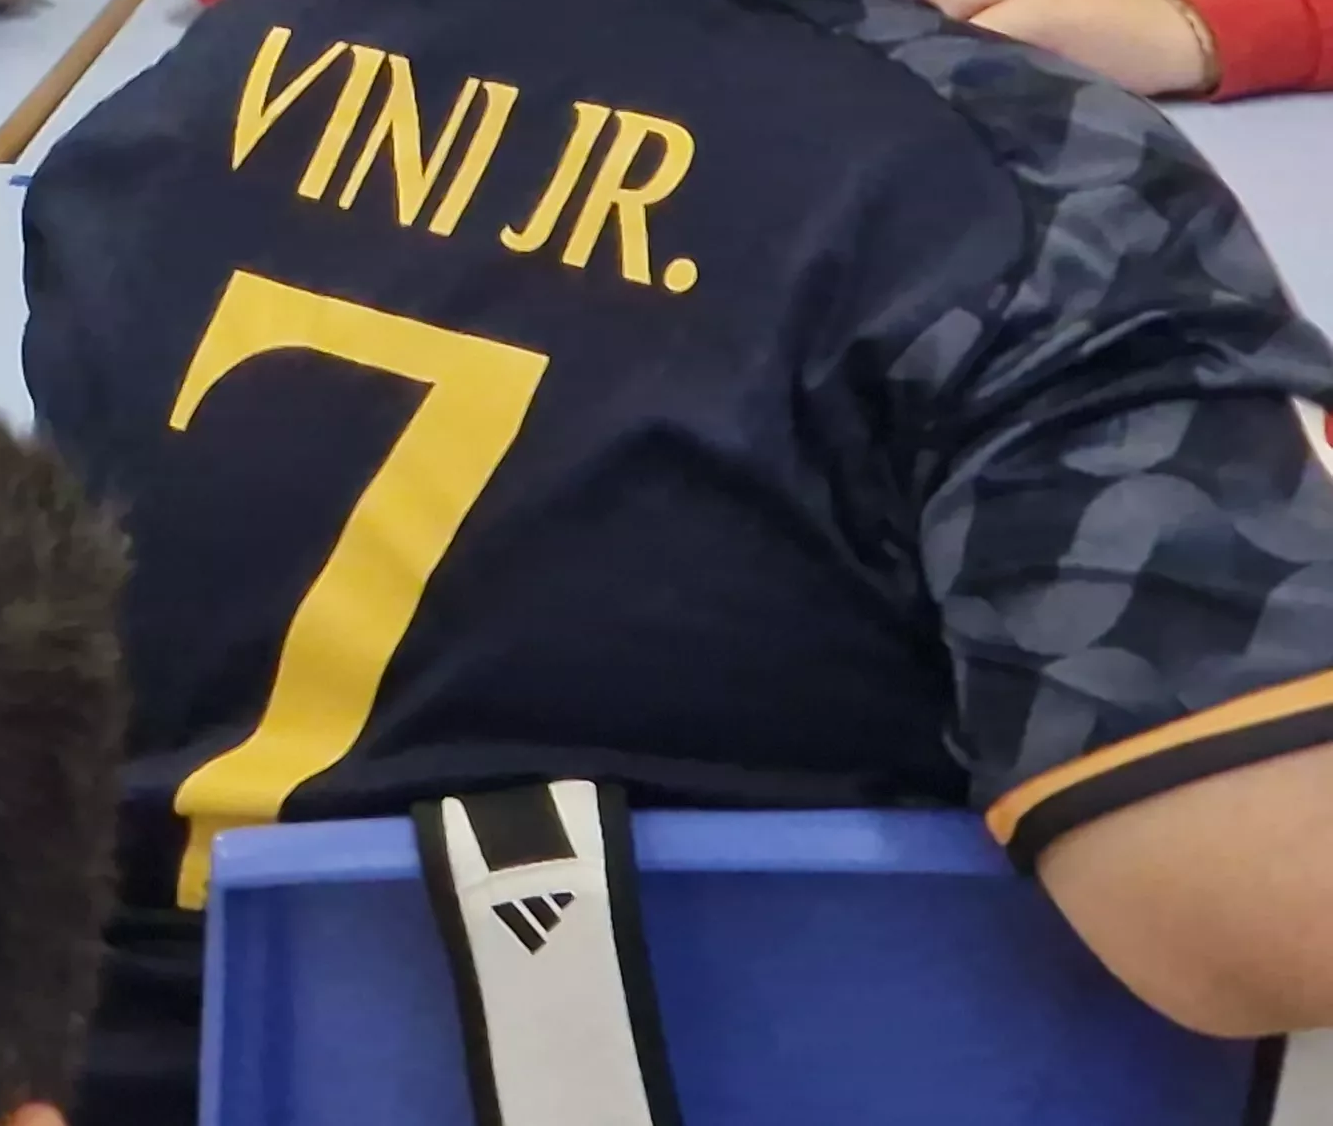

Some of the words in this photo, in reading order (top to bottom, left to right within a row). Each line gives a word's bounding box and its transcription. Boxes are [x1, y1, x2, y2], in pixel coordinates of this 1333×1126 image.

[232, 25, 520, 238] VINI
[499, 100, 699, 294] JR.
[169, 269, 550, 910] 7
